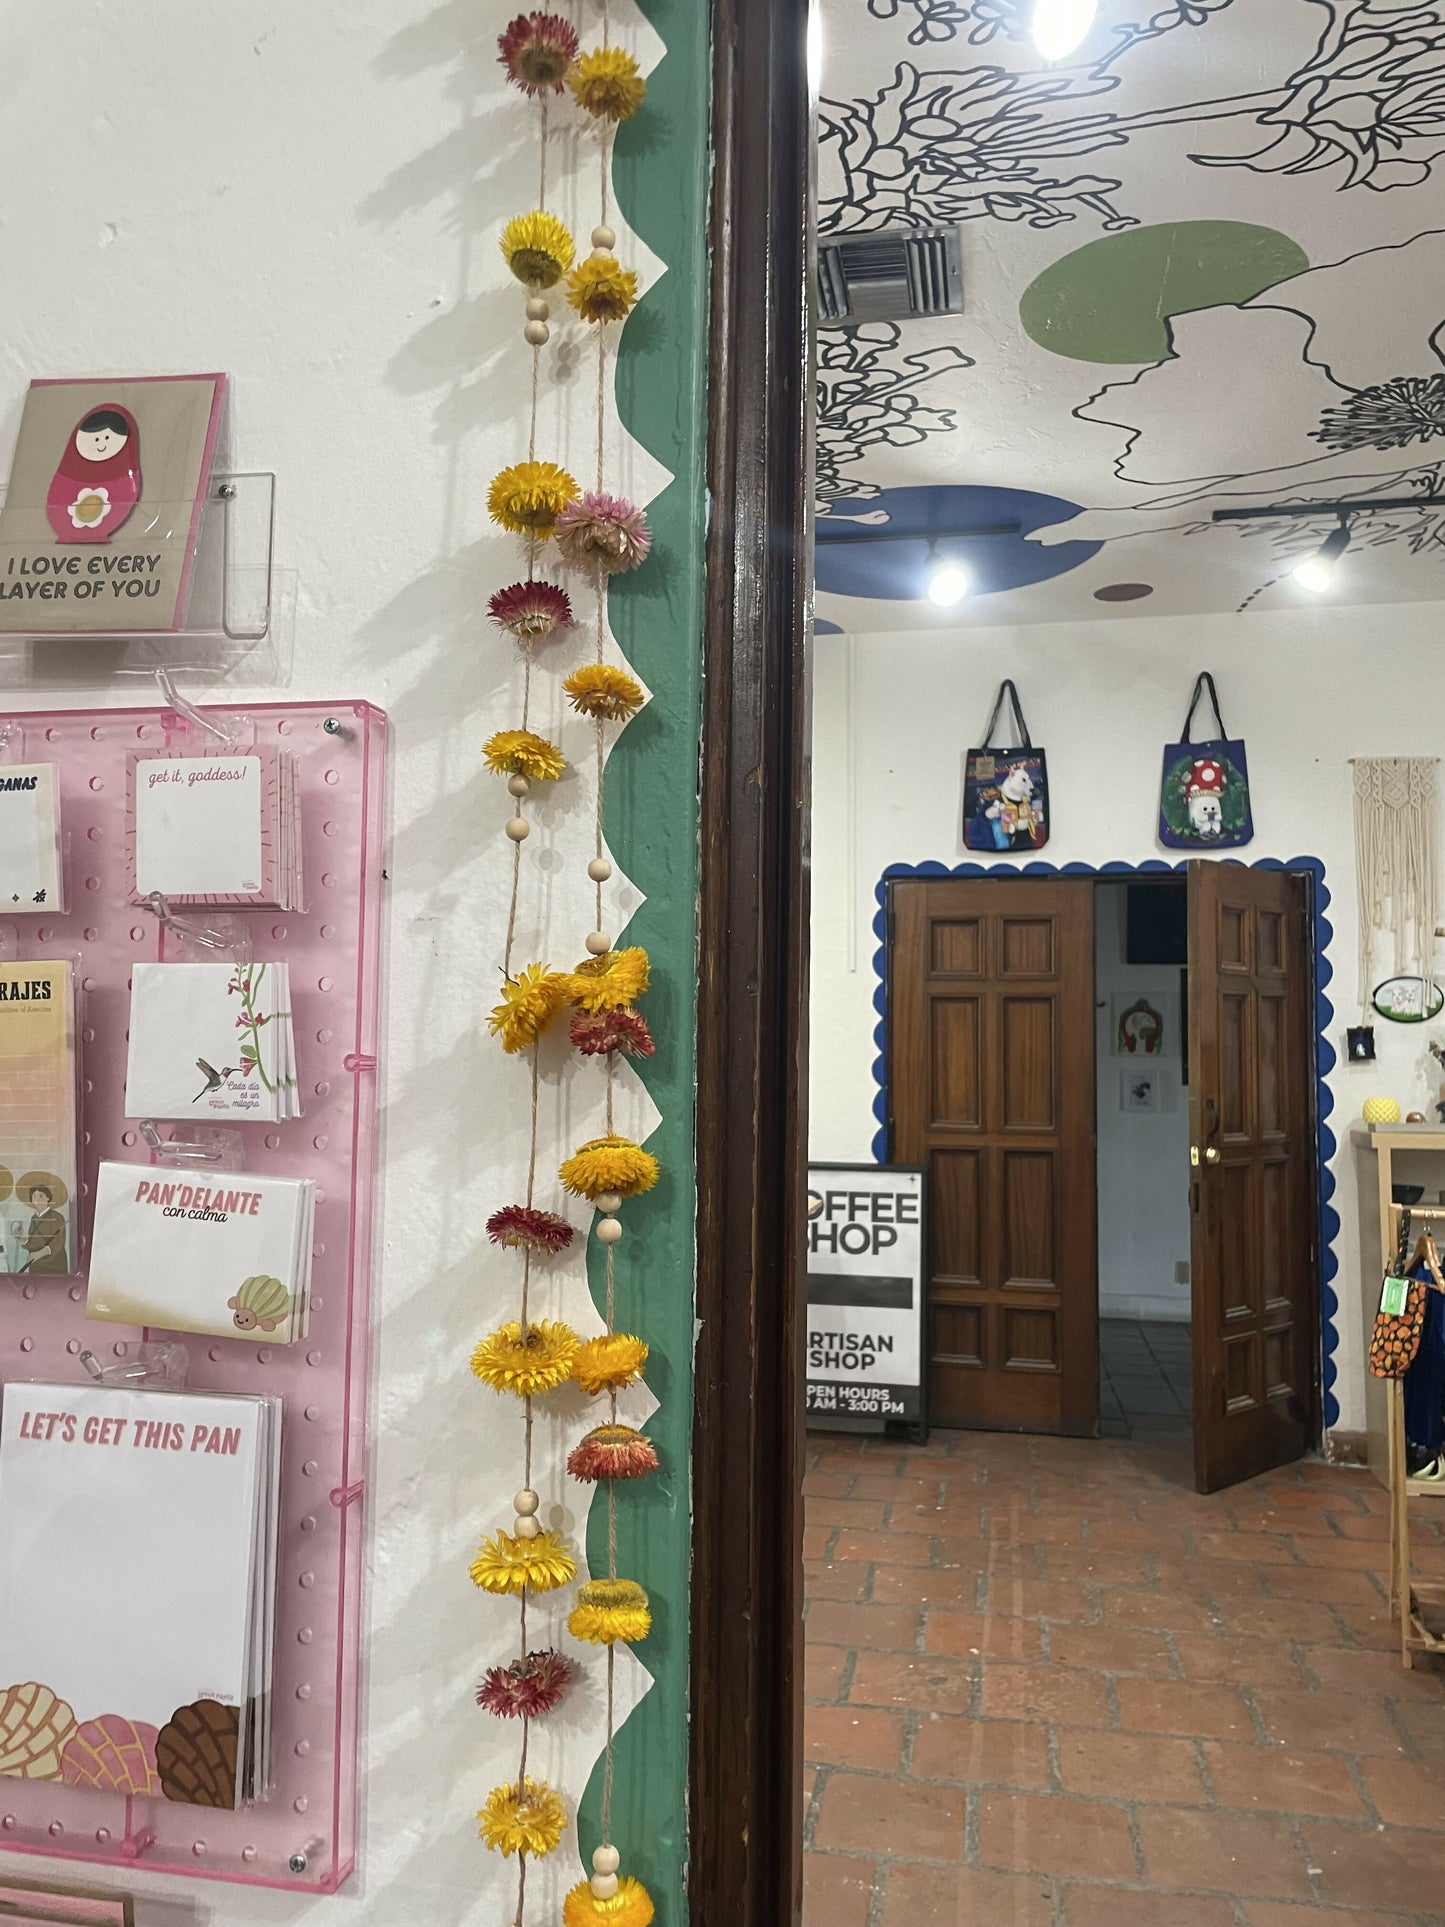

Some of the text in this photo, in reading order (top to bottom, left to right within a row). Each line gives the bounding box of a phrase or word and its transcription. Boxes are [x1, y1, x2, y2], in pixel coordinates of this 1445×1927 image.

[8, 554, 161, 575] I LOVE EVERY
[0, 579, 161, 600] LAYER OF YOU
[149, 766, 247, 788] get it, goddess!
[0, 981, 51, 1001] RAJES
[227, 1081, 246, 1091] Cada
[232, 1100, 260, 1110] milagro
[135, 1181, 263, 1216] PAN'DELANTE
[163, 1205, 228, 1223] con calma
[807, 1222, 898, 1256] HOP
[807, 1331, 894, 1353] RTISAN
[810, 1350, 876, 1370] SHOP
[839, 1386, 890, 1401] HOURS
[812, 1397, 837, 1410] AM
[847, 1399, 879, 1412] 3:00
[881, 1401, 905, 1414] PM
[19, 1411, 242, 1455] LET'S GET THIS PAN
